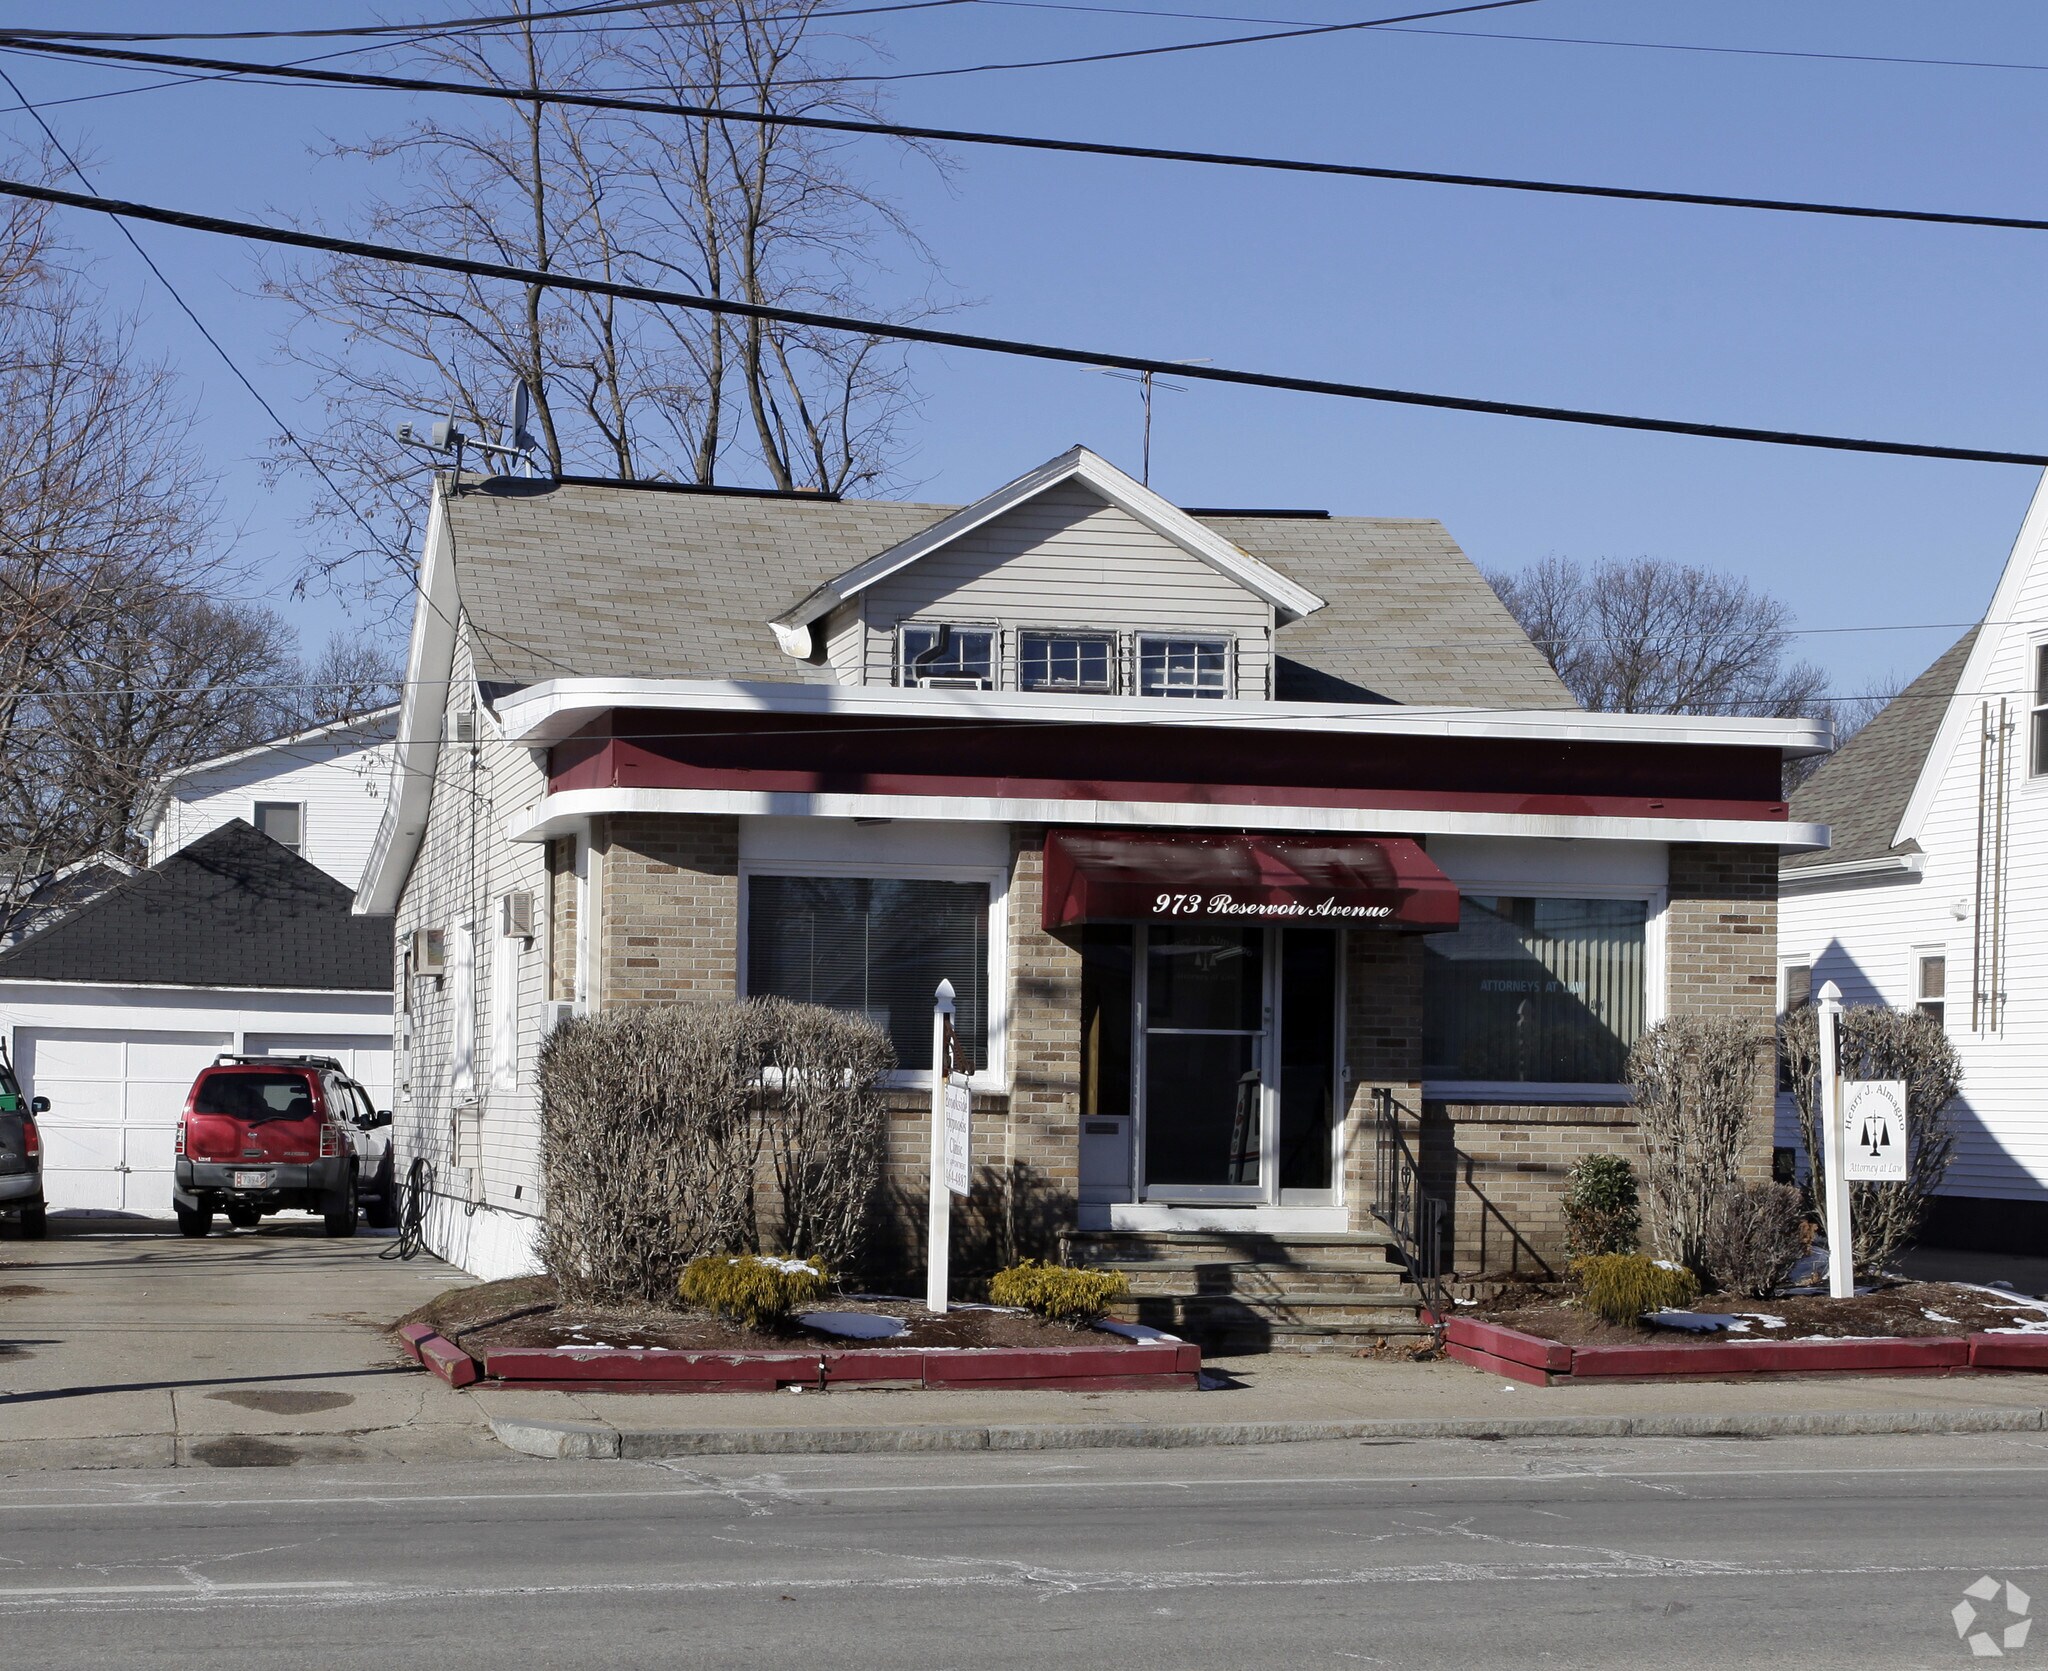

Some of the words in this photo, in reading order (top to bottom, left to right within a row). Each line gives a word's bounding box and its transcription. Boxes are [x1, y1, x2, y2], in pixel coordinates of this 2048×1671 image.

[1152, 893, 1202, 915] 973
[1206, 893, 1309, 916] Reservoir
[1308, 896, 1394, 918] Avenue
[1480, 979, 1541, 993] ATTORNEYS
[1545, 980, 1558, 993] AT
[1563, 981, 1586, 994] LAW
[945, 1092, 967, 1113] Brookside
[1845, 1092, 1863, 1131] Henry
[1864, 1084, 1874, 1096] J.
[1876, 1084, 1905, 1131] Almagno
[946, 1112, 967, 1133] Hypnosis
[949, 1137, 963, 1157] Clinic
[1849, 1162, 1879, 1176] Attorney
[1879, 1163, 1887, 1173] at
[1888, 1163, 1903, 1173] Law
